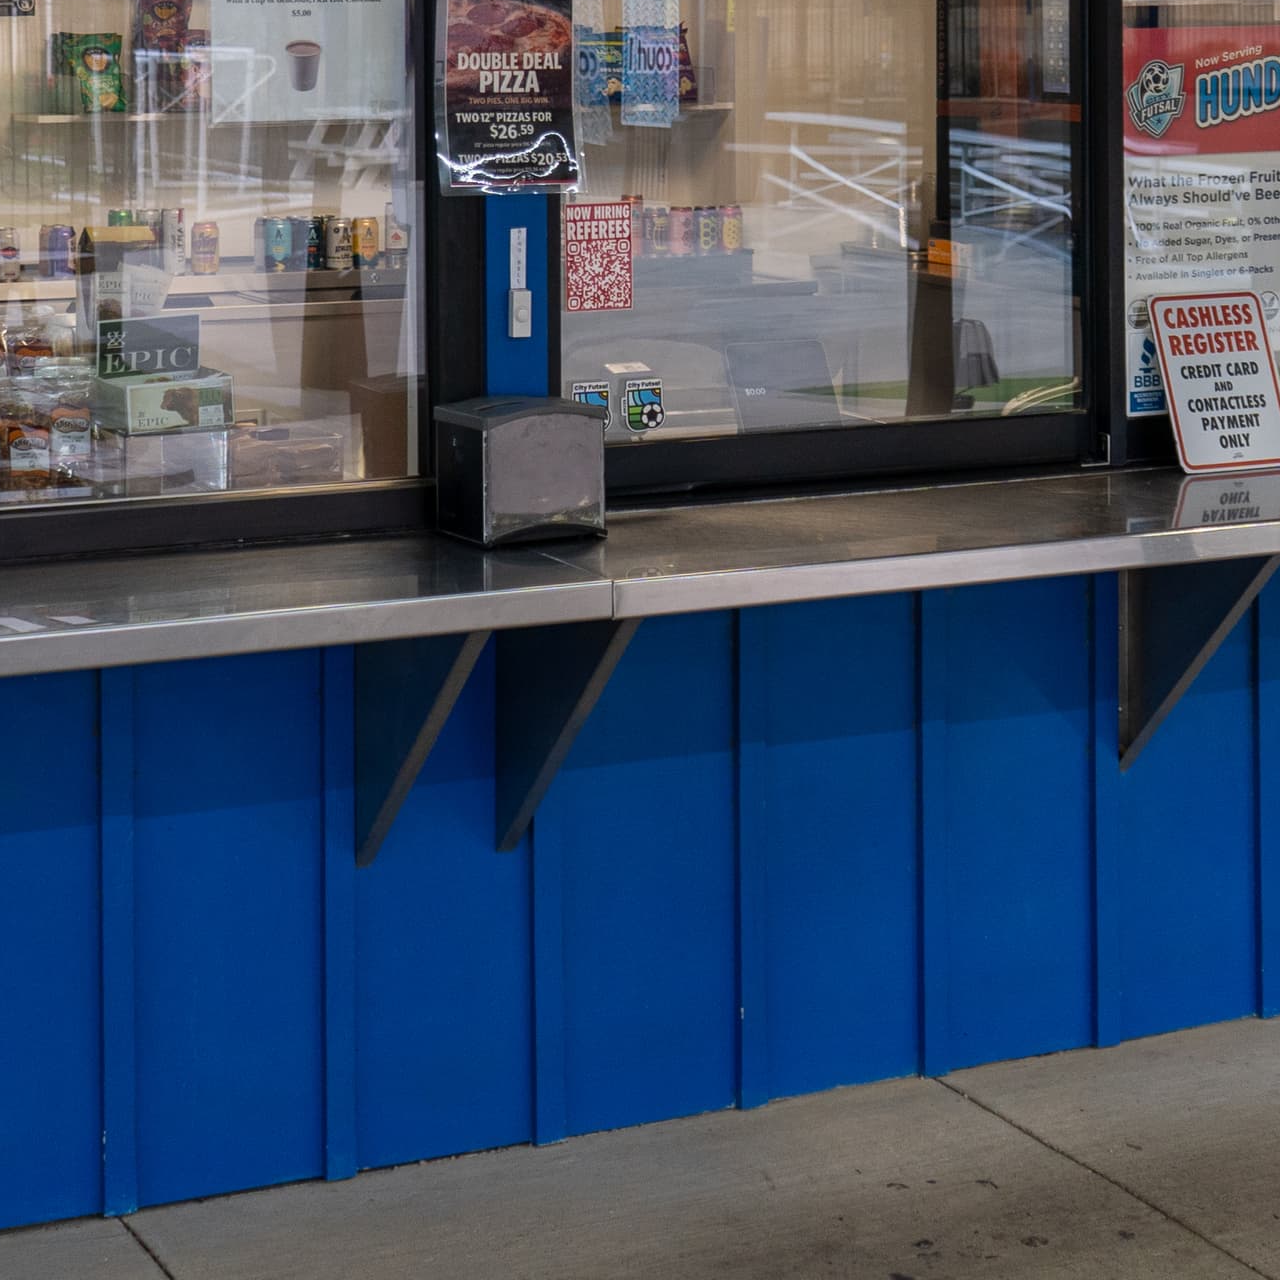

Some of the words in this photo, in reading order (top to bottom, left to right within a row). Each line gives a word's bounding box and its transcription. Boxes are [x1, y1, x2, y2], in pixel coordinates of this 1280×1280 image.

[457, 53, 518, 70] DOUBLE
[523, 53, 562, 69] DEAL
[1195, 56, 1220, 69] Now
[1221, 45, 1262, 65] Serving
[479, 71, 539, 93] PIZZA
[456, 113, 479, 122] TWO
[496, 113, 530, 122] PIZZAS
[532, 112, 552, 122] FOR
[1140, 99, 1177, 121] FUTSAL
[490, 125, 534, 139] $26.59
[1128, 176, 1165, 189] What
[1170, 174, 1193, 187] the
[1198, 172, 1245, 186] Frozen
[1249, 171, 1280, 183] Fruit
[1128, 192, 1178, 209] Always
[1183, 189, 1250, 204] Should've
[567, 206, 590, 220] NOW
[594, 205, 629, 219] HIRING
[568, 220, 630, 240] REFEREES
[1164, 304, 1253, 329] CASHLESS
[1168, 330, 1259, 356] REGISTER
[105, 346, 192, 374] EPIC
[1181, 364, 1221, 379] CREDIT
[1227, 362, 1259, 376] CARD
[1134, 375, 1161, 388] BBB
[1214, 381, 1233, 392] AND
[1188, 394, 1266, 413] CONTACTLESS
[1202, 414, 1260, 431] PAYMENT
[1219, 434, 1250, 449] ONLY
